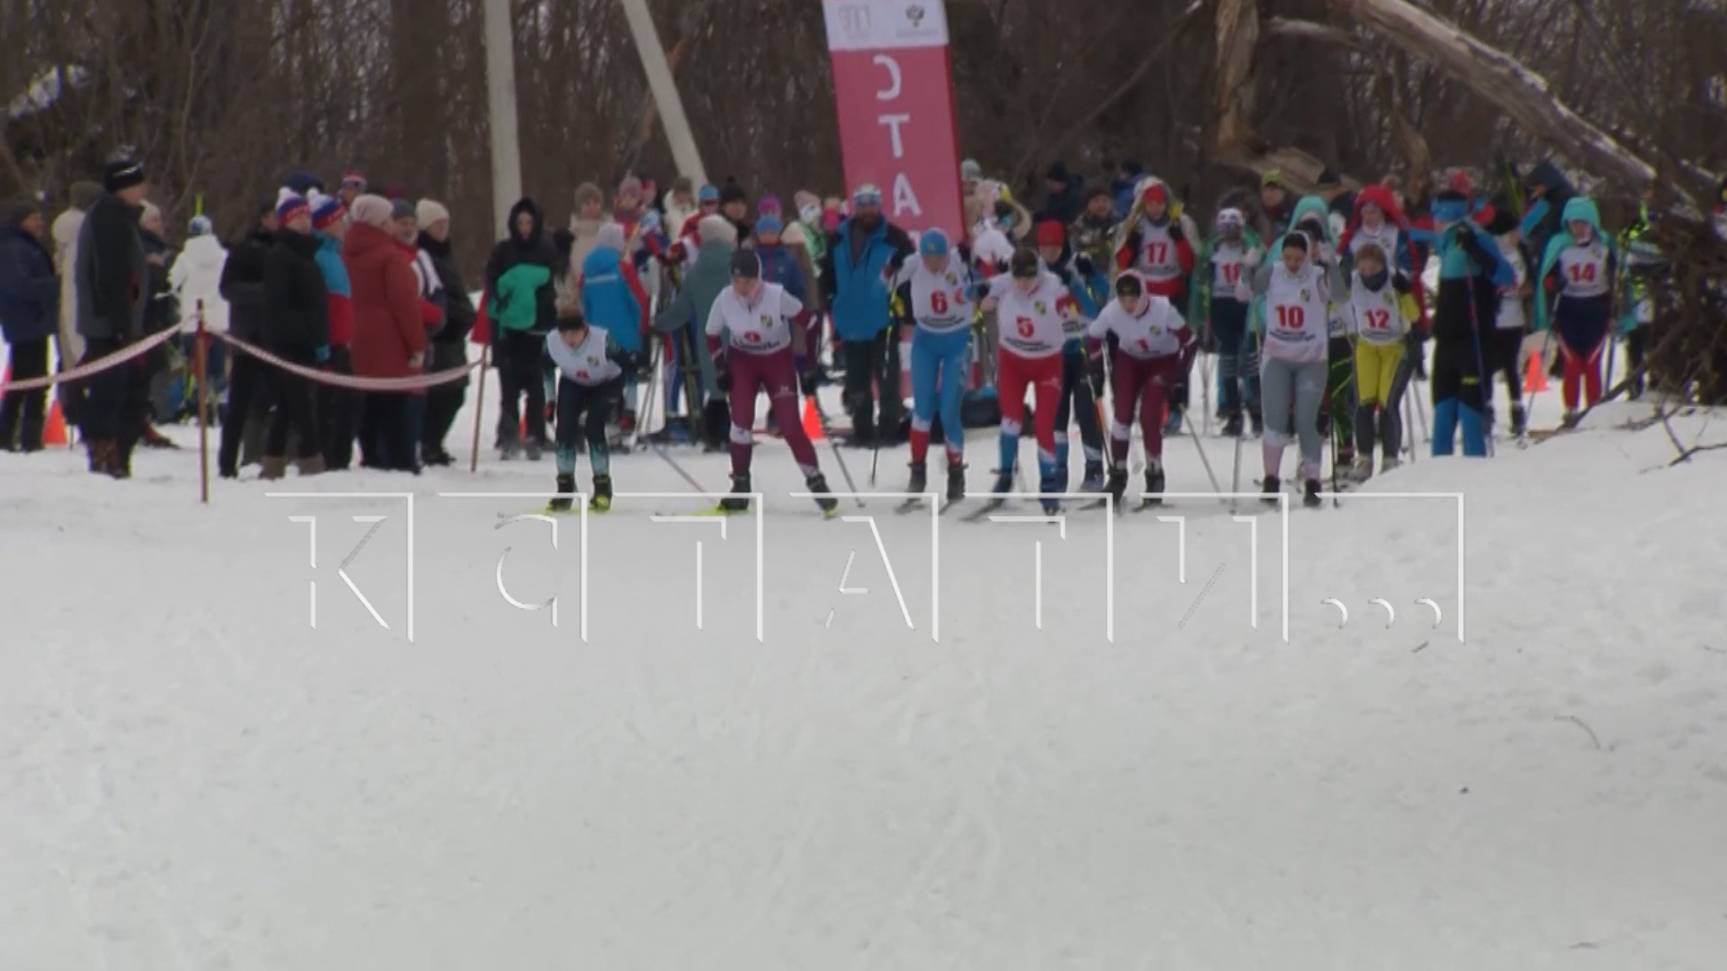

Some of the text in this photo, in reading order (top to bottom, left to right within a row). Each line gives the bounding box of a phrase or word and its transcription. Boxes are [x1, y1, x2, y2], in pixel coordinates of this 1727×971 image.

[1145, 241, 1168, 265] 17
[1569, 263, 1596, 282] 14
[930, 290, 949, 315] 6
[1016, 315, 1034, 337] 5
[1275, 304, 1305, 329] 10
[1365, 308, 1390, 329] 12
